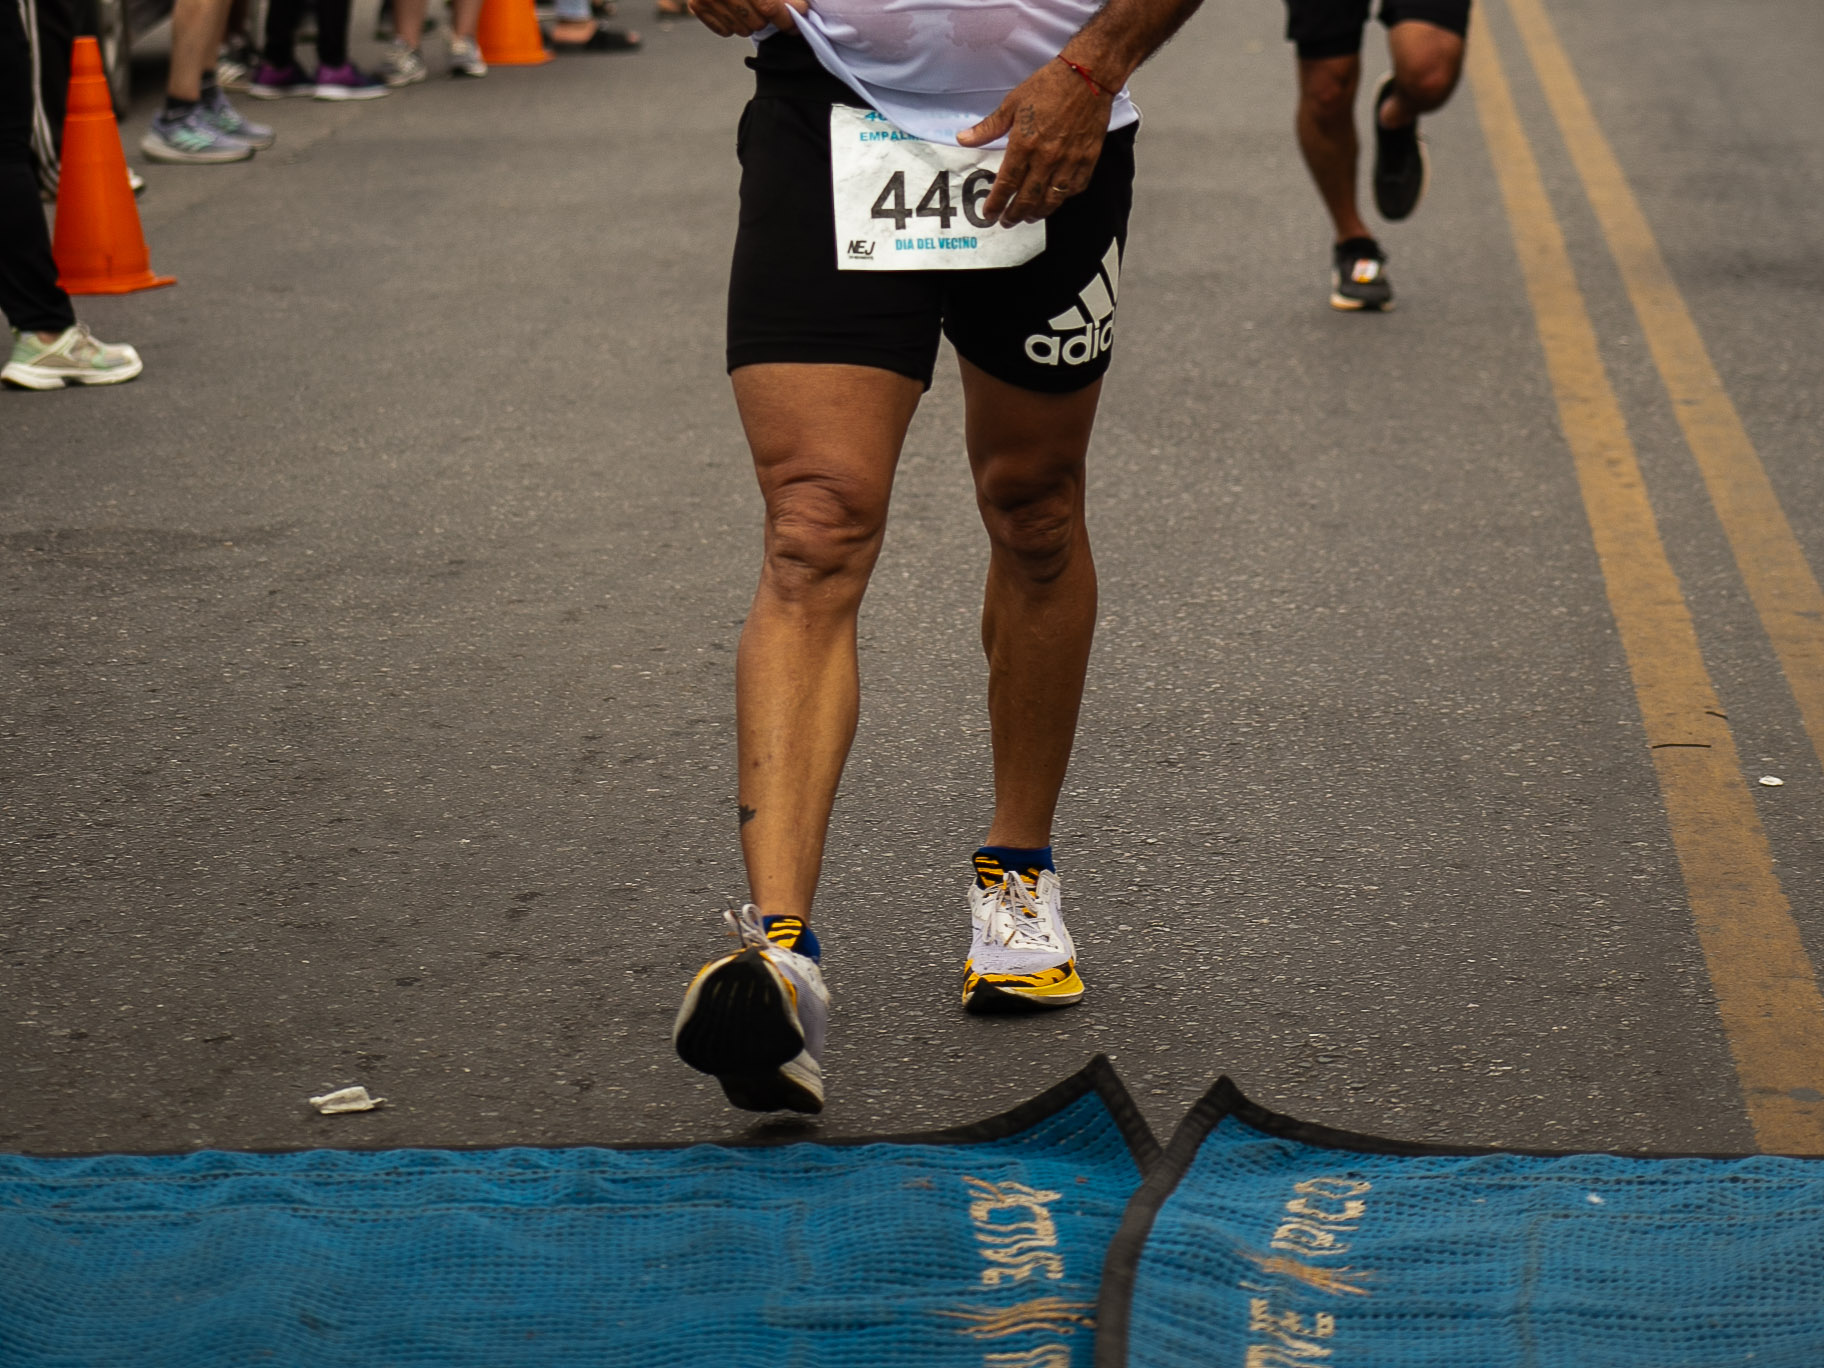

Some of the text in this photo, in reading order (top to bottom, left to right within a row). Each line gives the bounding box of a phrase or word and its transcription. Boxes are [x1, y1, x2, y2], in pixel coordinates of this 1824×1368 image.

[870, 168, 998, 230] 446
[895, 236, 978, 251] DIA DEL VECINO
